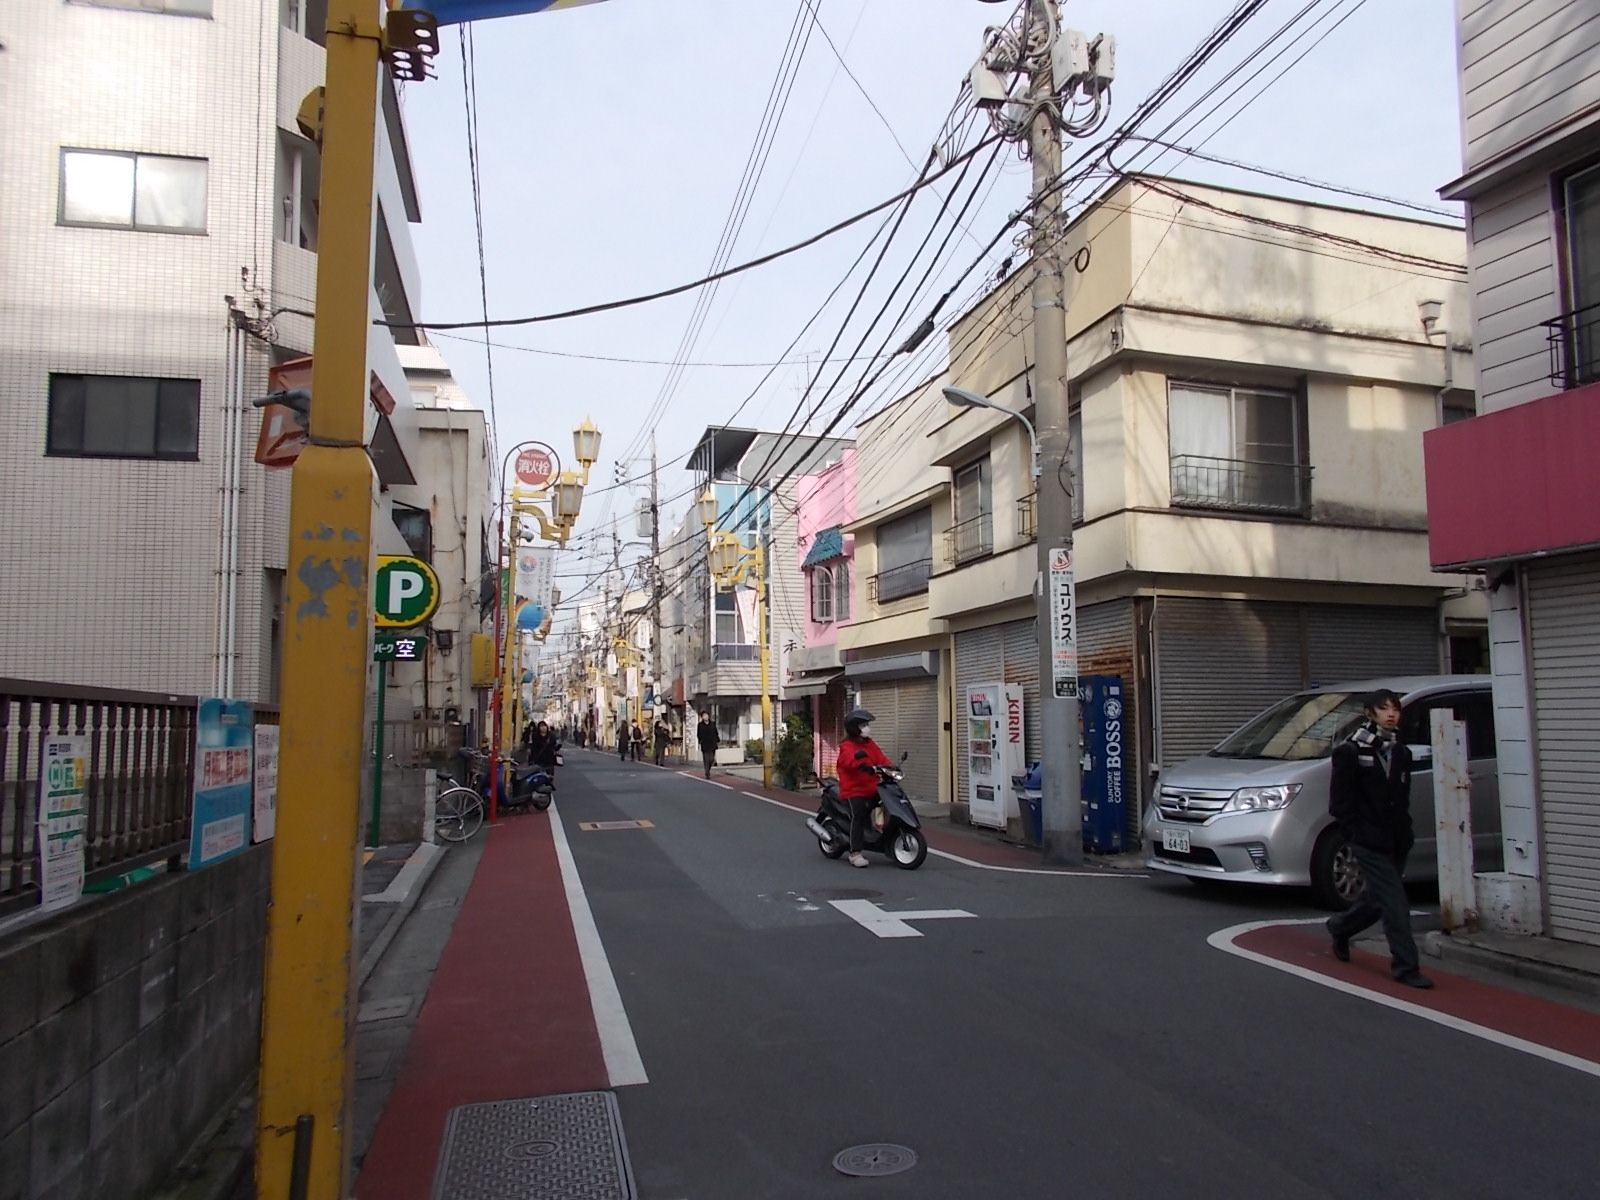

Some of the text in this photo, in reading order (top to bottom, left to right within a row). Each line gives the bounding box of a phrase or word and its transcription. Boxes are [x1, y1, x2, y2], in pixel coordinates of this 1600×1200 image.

[517, 459, 551, 475] 消火栓
[388, 570, 424, 614] P
[1060, 583, 1073, 641] ユリウス
[396, 639, 415, 657] 空
[1008, 699, 1020, 744] KIRIN
[1106, 720, 1122, 769] BOSS
[1114, 771, 1122, 803] COFFEE
